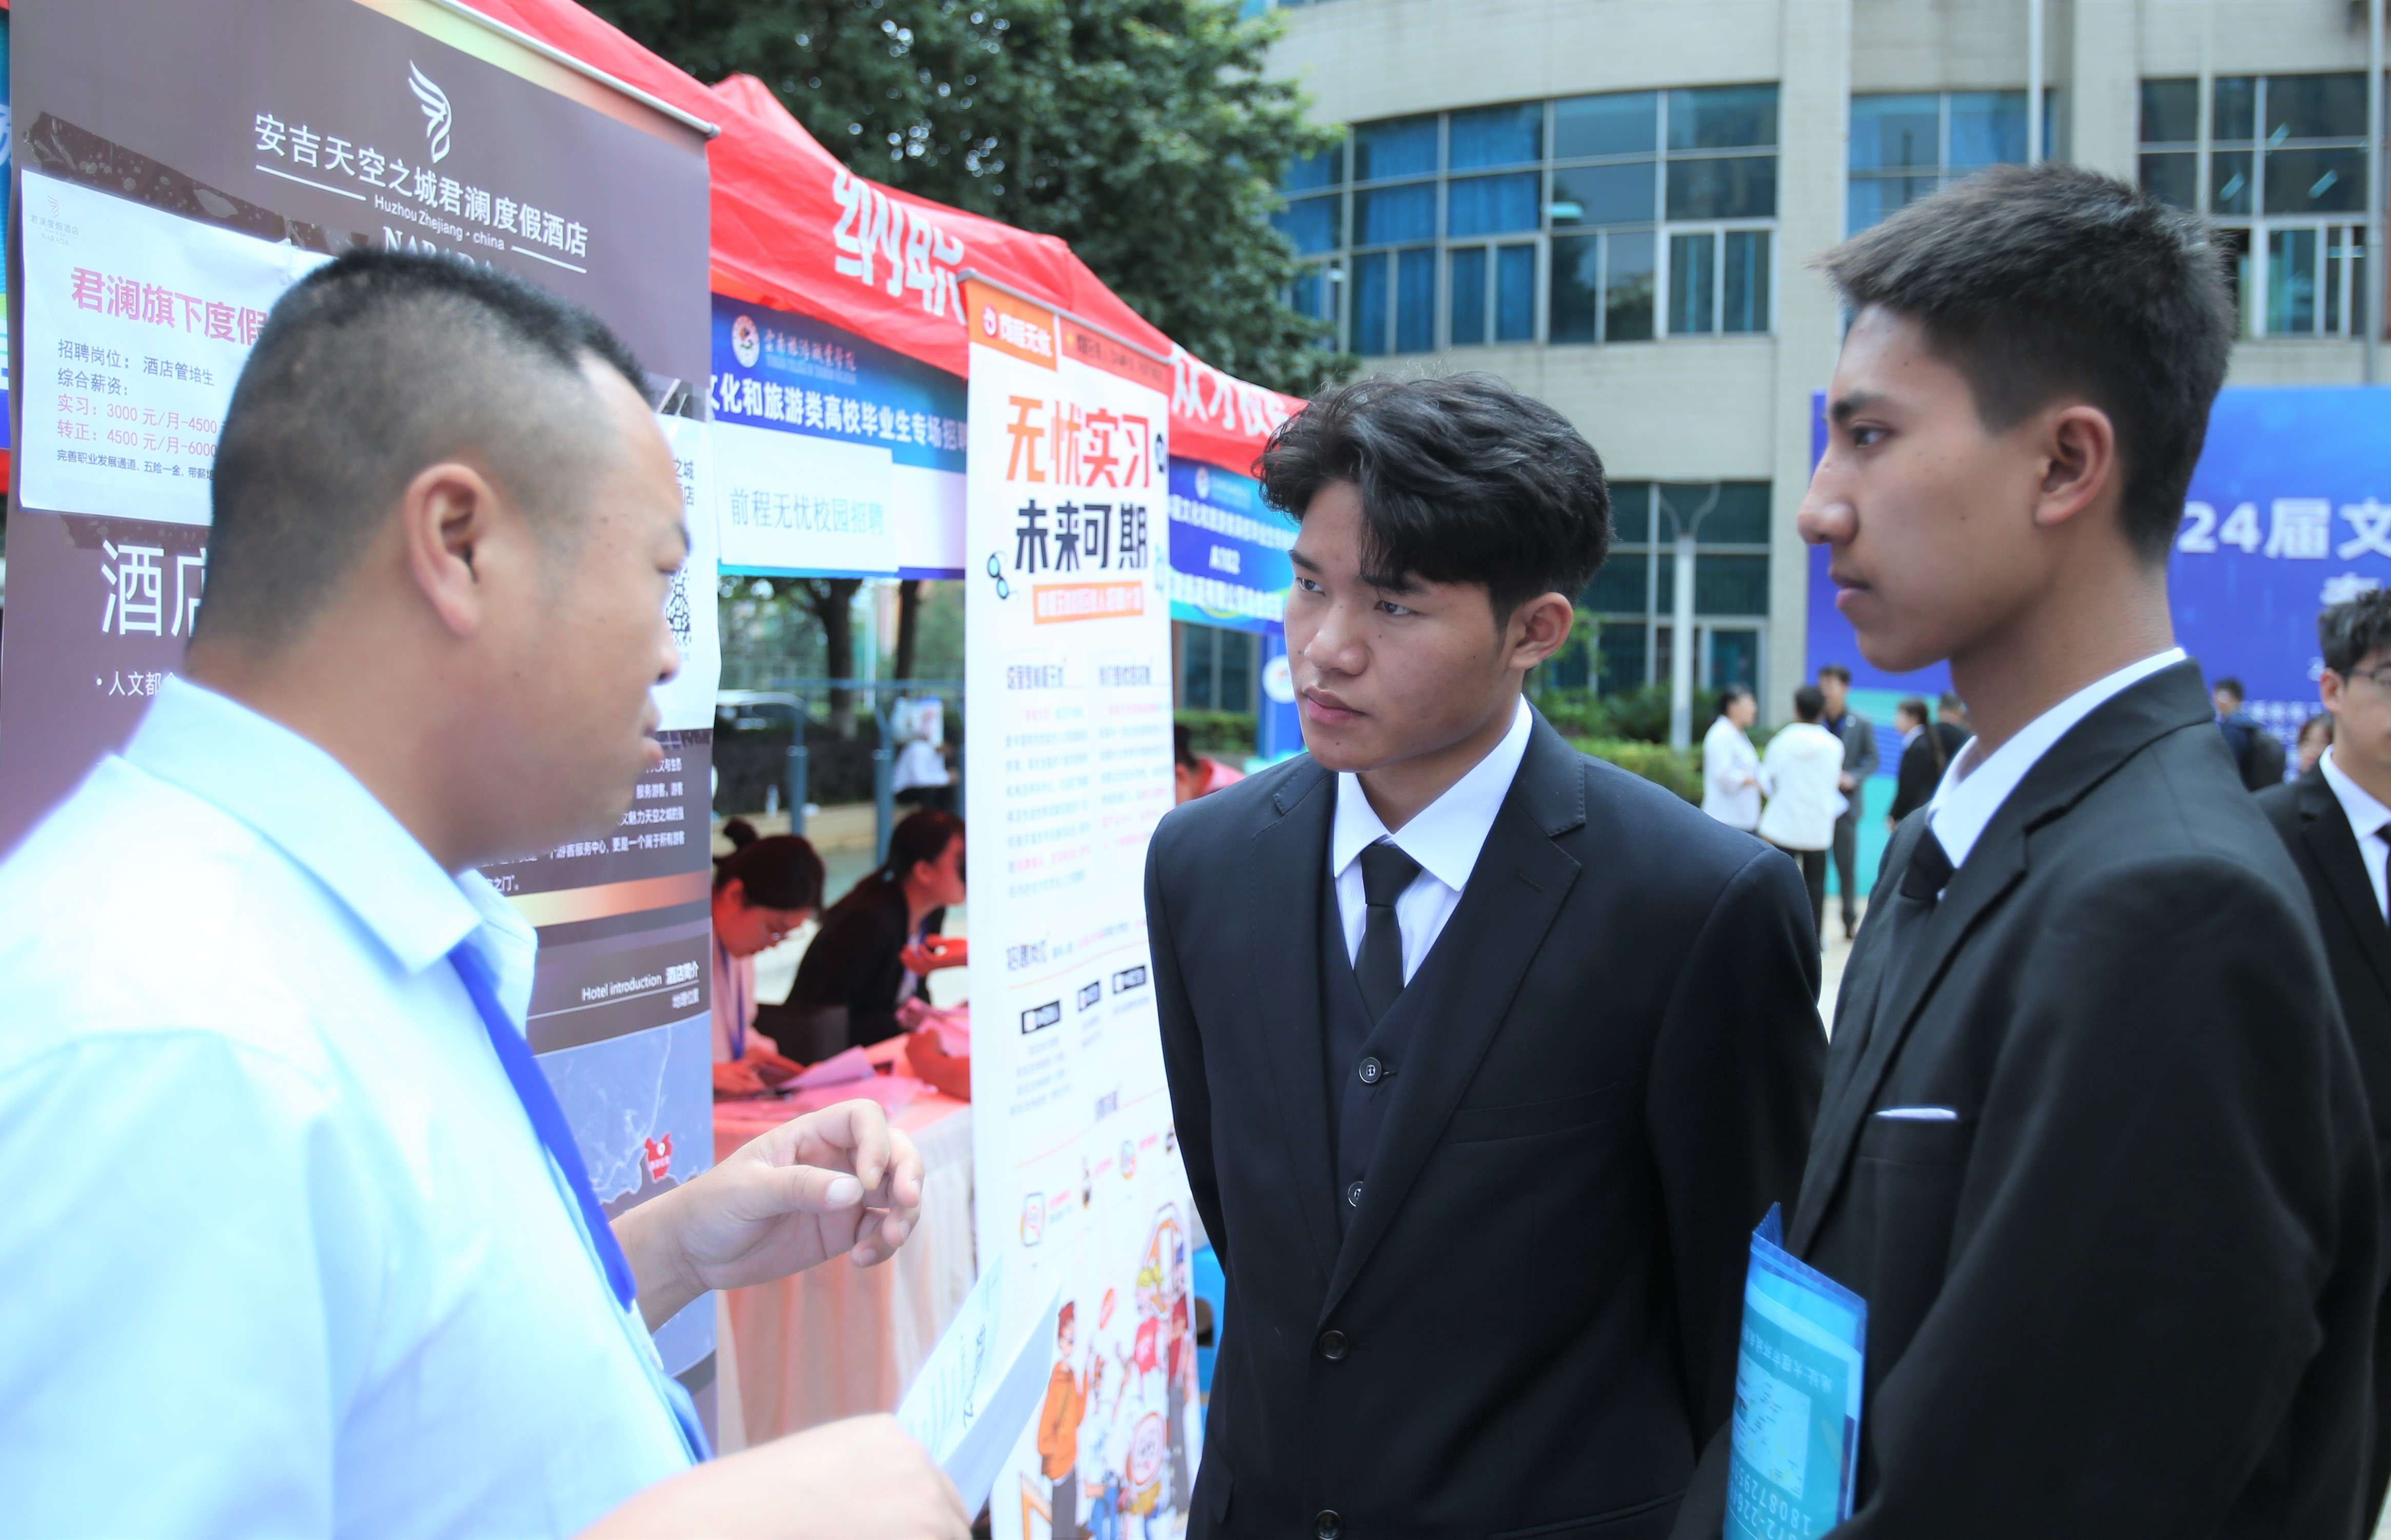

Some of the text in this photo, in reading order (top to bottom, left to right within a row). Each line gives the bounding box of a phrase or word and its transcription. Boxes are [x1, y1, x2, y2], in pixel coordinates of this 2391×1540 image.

[255, 114, 588, 258] 安吉天空之城君澜度假酒店
[374, 194, 417, 221] Huzhou
[418, 210, 463, 241] Zhejiang
[472, 231, 505, 250] china
[143, 356, 214, 386] 酒店管培生
[1006, 394, 1149, 488] 无忧实习
[730, 487, 884, 536] 前程无忧校园招聘
[1015, 499, 1148, 574] 未来可期
[109, 670, 175, 696] 人文都
[581, 983, 608, 1001] Hotel
[610, 974, 662, 996] introduction
